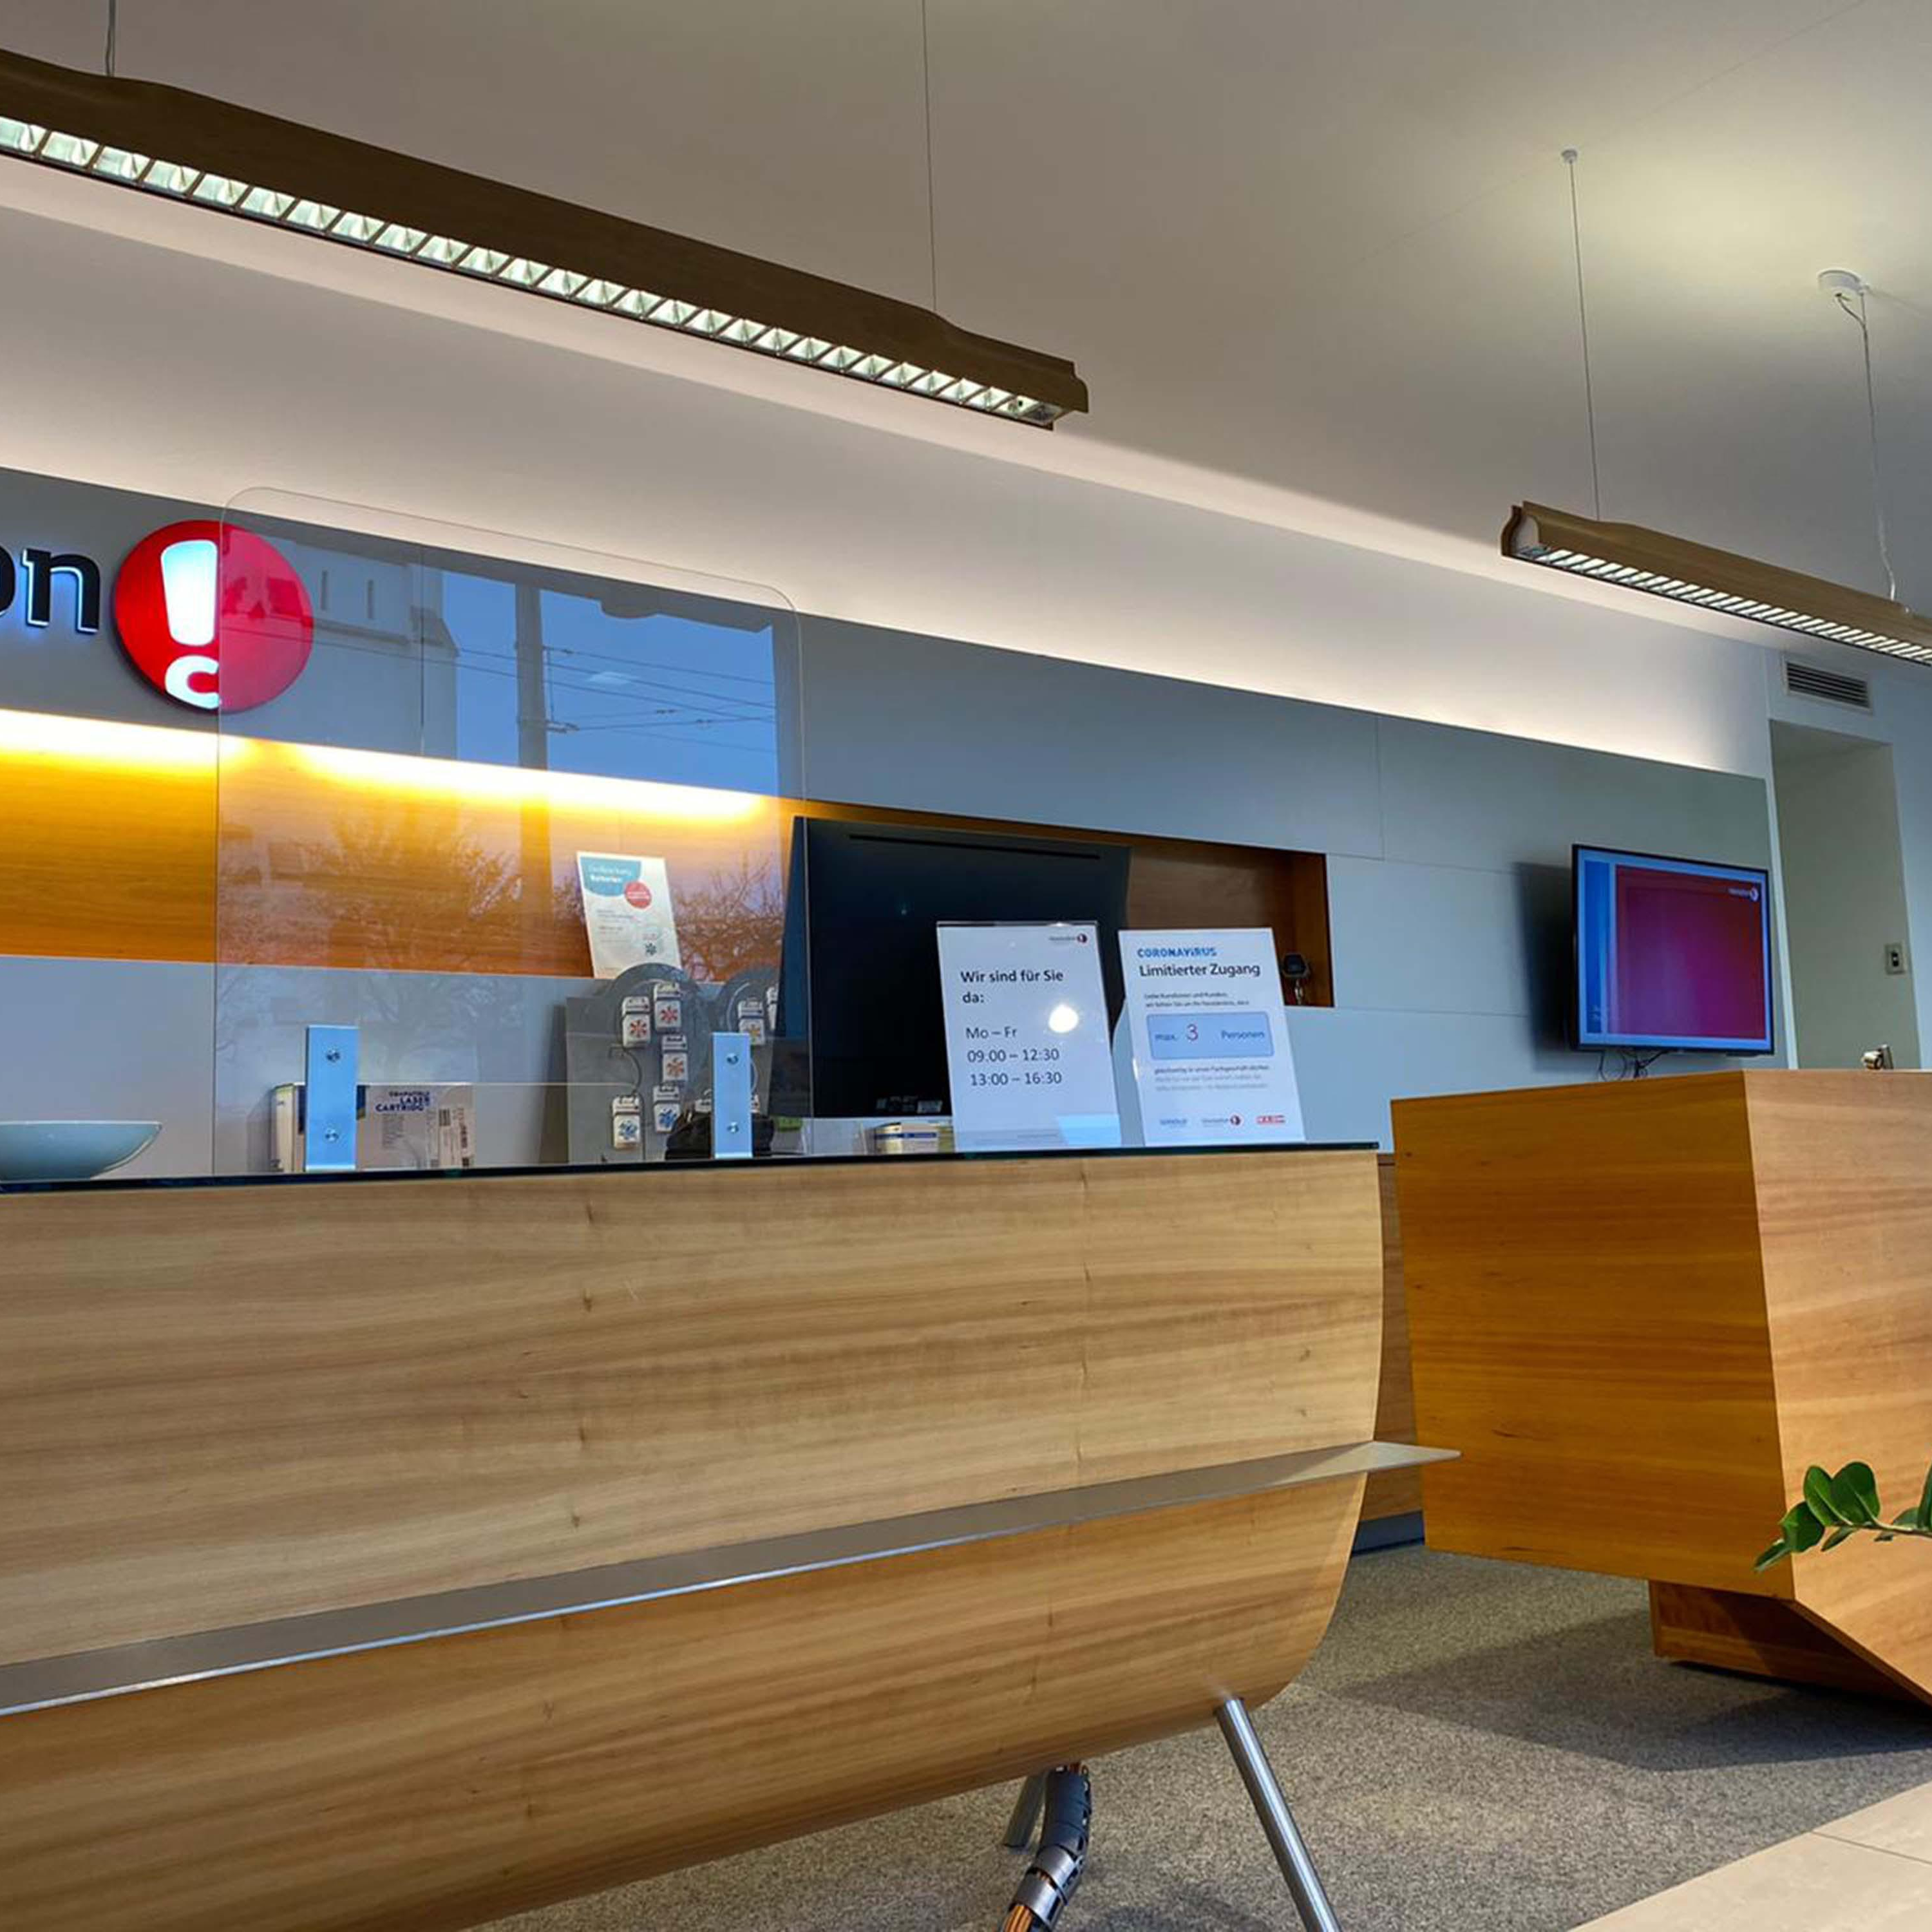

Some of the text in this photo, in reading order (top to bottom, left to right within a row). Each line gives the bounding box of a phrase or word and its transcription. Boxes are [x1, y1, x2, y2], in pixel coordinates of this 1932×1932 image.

[1137, 947, 1217, 958] CORONAVIRUS
[960, 969, 1063, 983] Wir sind für Sie
[1139, 963, 1260, 977] Limitierter Zugang
[962, 991, 985, 1003] da:
[966, 1027, 989, 1039] Mo
[1004, 1026, 1018, 1038] Fr
[1186, 1023, 1198, 1041] 3
[1023, 1048, 1059, 1061] 12:30
[971, 1072, 1009, 1086] 13:00
[1025, 1072, 1062, 1084] 16:30
